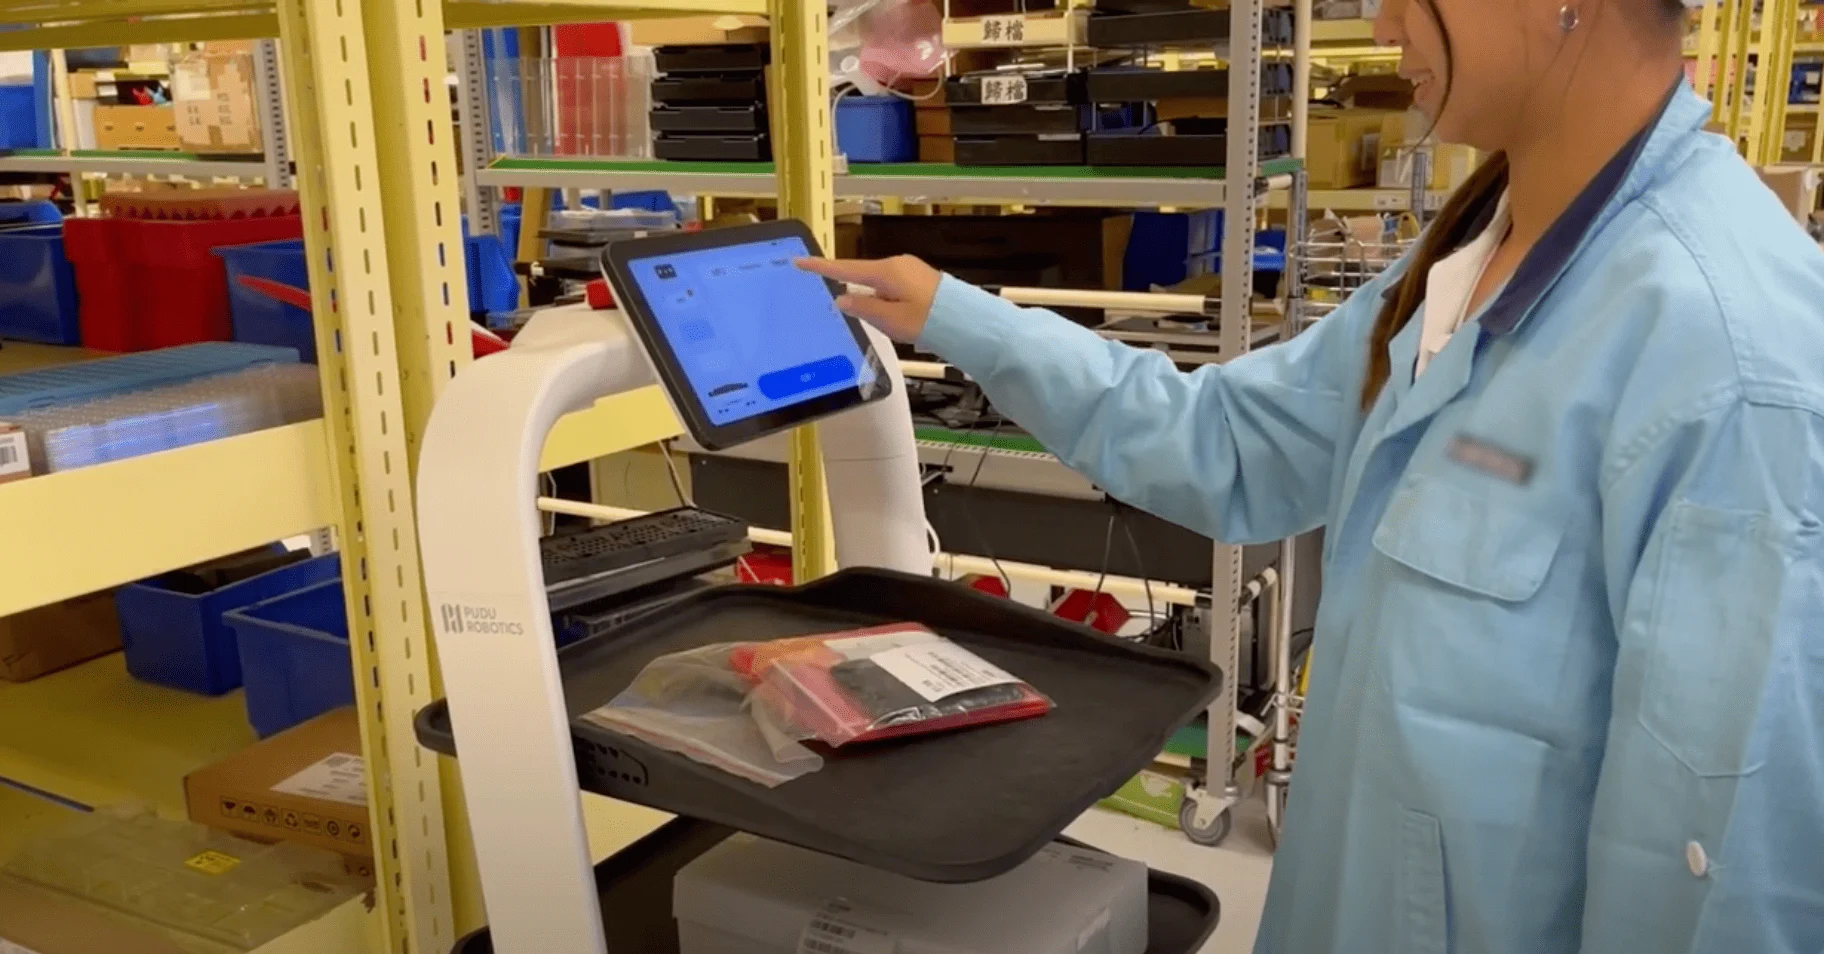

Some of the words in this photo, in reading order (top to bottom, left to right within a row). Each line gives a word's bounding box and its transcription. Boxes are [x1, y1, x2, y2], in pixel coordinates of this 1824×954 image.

[983, 19, 1024, 41] 歸檔
[985, 80, 1025, 101] 歸檔
[464, 606, 497, 620] PUDU
[466, 620, 524, 636] ROBOTICS
